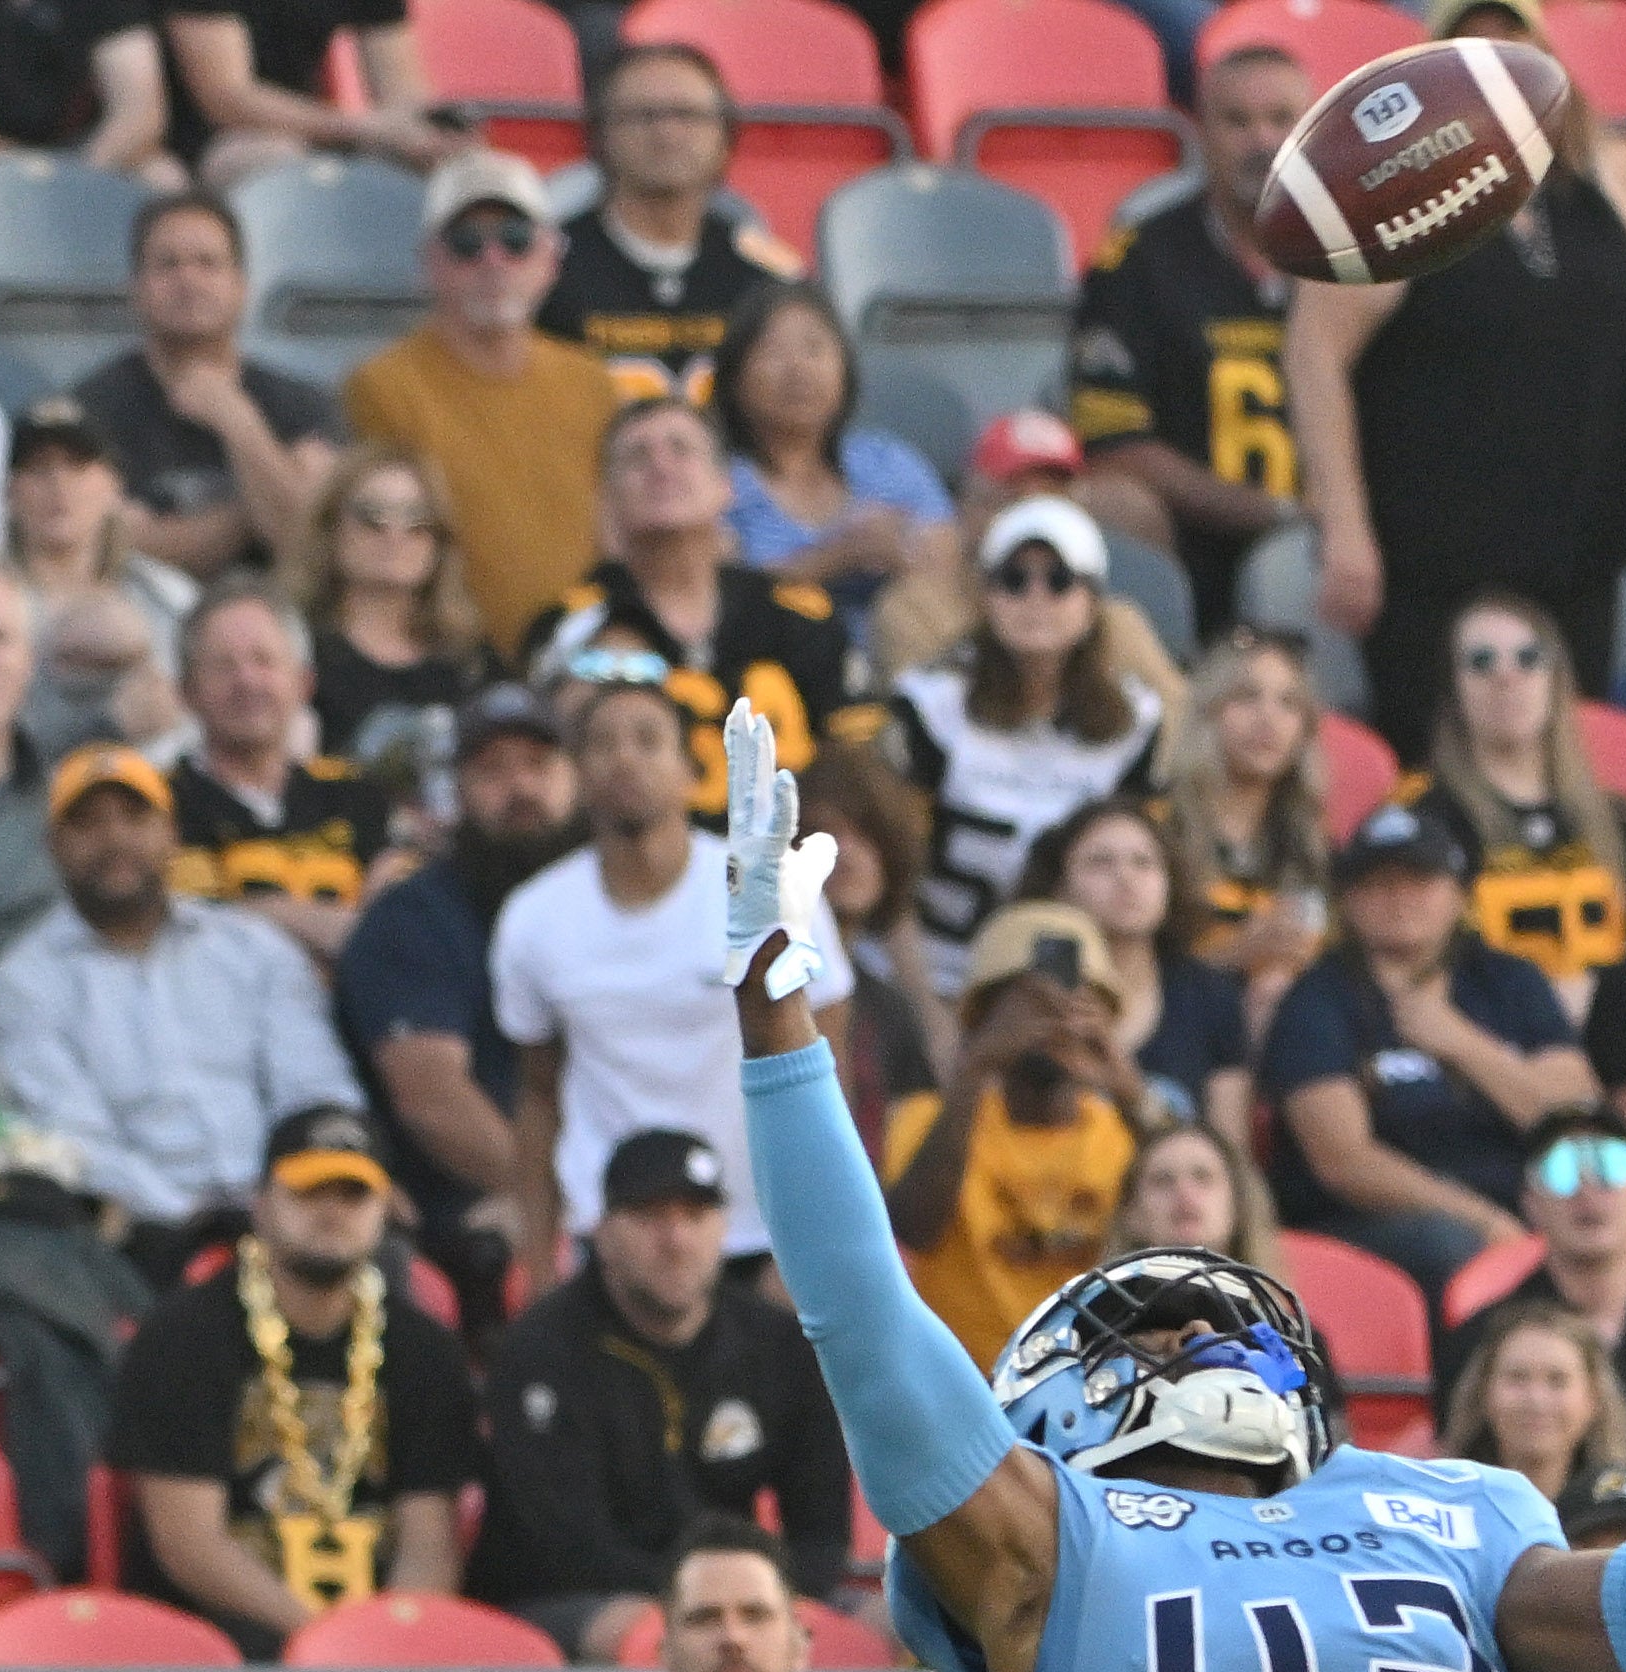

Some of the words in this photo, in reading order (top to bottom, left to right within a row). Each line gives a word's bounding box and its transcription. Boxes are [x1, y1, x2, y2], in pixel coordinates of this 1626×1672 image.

[1361, 91, 1408, 125] CFL
[1357, 120, 1475, 192] Wilson
[1385, 1499, 1456, 1541] Bell
[1210, 1532, 1385, 1560] ARGOS
